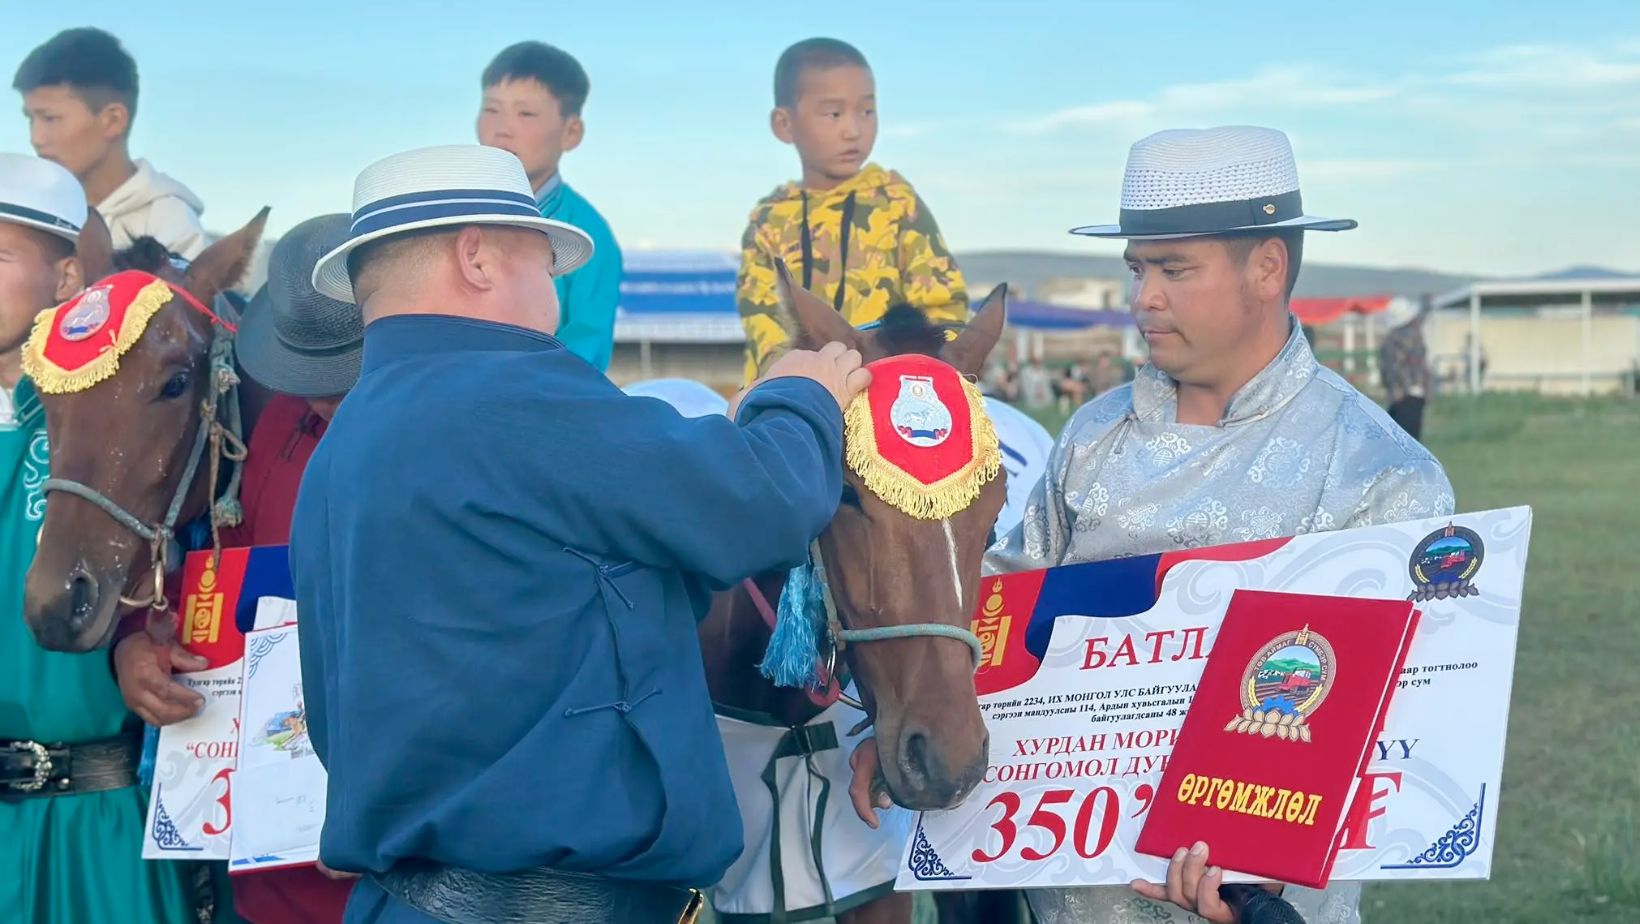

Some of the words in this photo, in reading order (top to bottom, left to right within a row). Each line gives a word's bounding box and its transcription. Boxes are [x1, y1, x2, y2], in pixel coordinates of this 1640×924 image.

[1079, 627, 1209, 670] БАТЛ
[1048, 695, 1063, 704] ИХ
[1066, 691, 1111, 702] МОНГОЛ
[1114, 689, 1136, 698] УЛС
[1138, 684, 1197, 696] БАЙГУУЛА
[1099, 702, 1128, 712] Ардын
[1131, 698, 1185, 710] хувьсгалын
[1411, 678, 1431, 688] сум
[1166, 708, 1177, 717] 48
[1012, 734, 1107, 757] ХУРДАН
[1177, 773, 1323, 826] ӨРГӨМЖЛӨЛ
